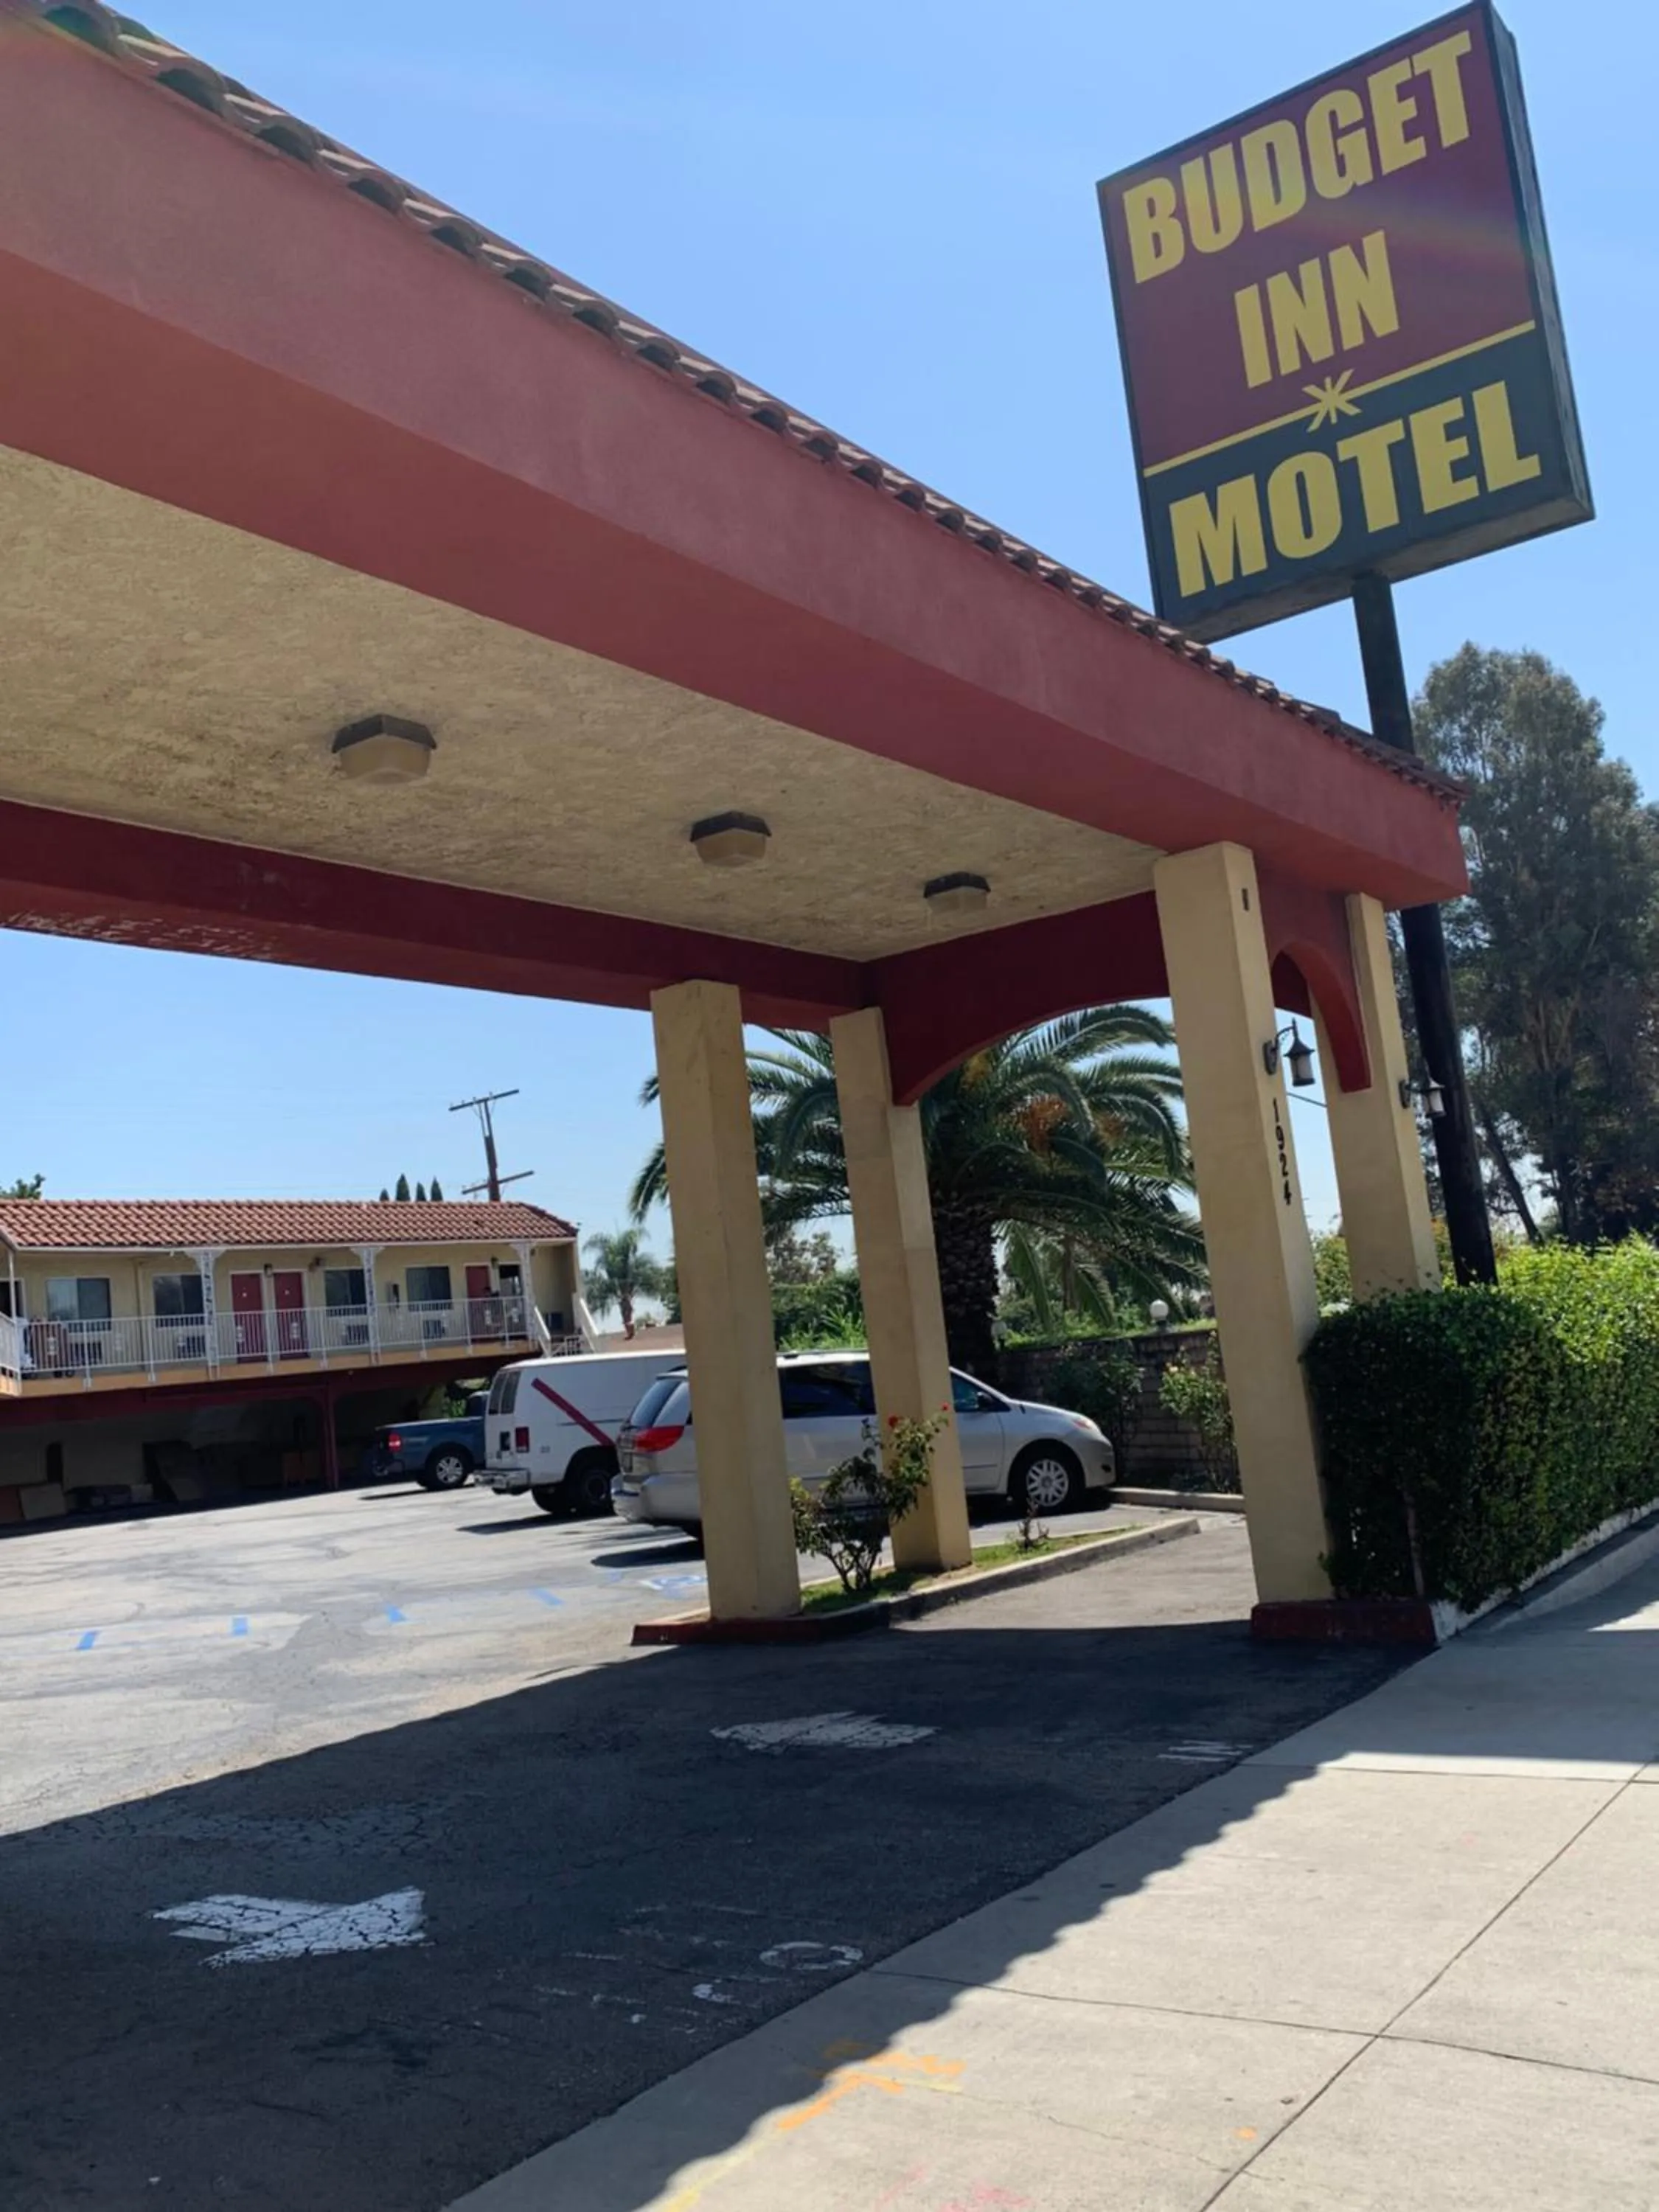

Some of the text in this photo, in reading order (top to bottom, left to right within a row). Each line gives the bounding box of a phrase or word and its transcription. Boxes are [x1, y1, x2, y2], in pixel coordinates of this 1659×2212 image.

[1123, 30, 1472, 284] BUDGET
[1234, 231, 1399, 389] INN
[1169, 381, 1542, 597] MOTEL
[1273, 1096, 1292, 1206] 1924
